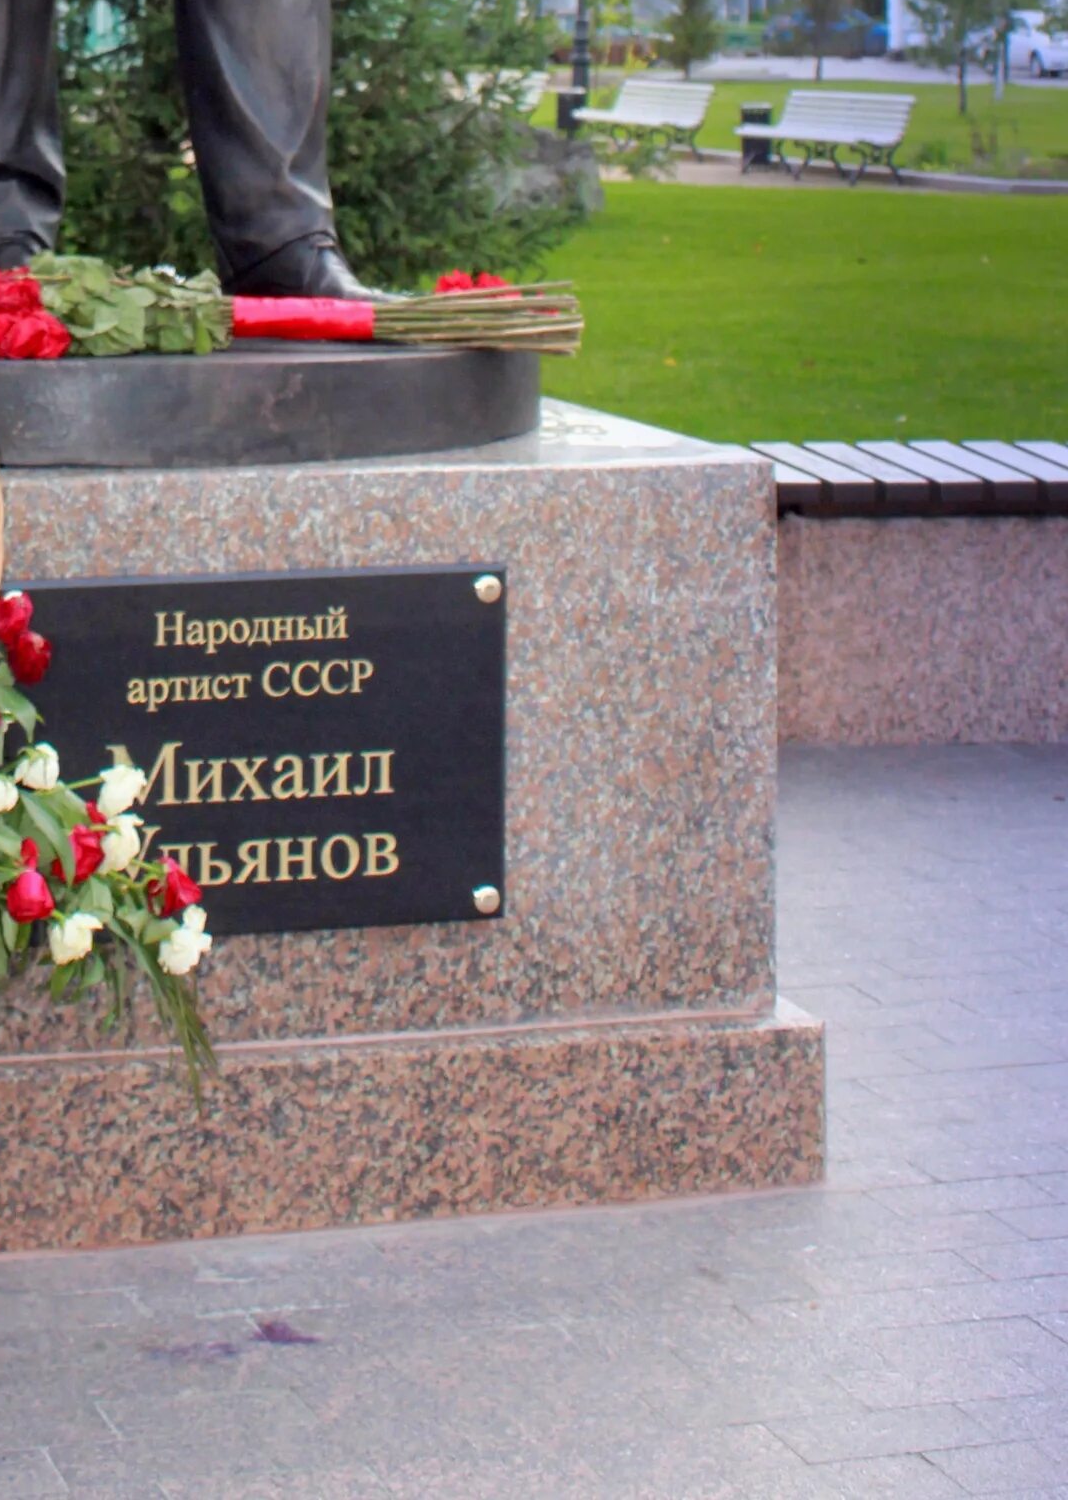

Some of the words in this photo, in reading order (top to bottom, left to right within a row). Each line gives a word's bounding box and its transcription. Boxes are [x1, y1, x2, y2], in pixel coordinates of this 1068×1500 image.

[154, 606, 349, 654] Народный
[126, 671, 252, 712] артист
[261, 658, 374, 698] СССР
[105, 741, 395, 807] Михаил
